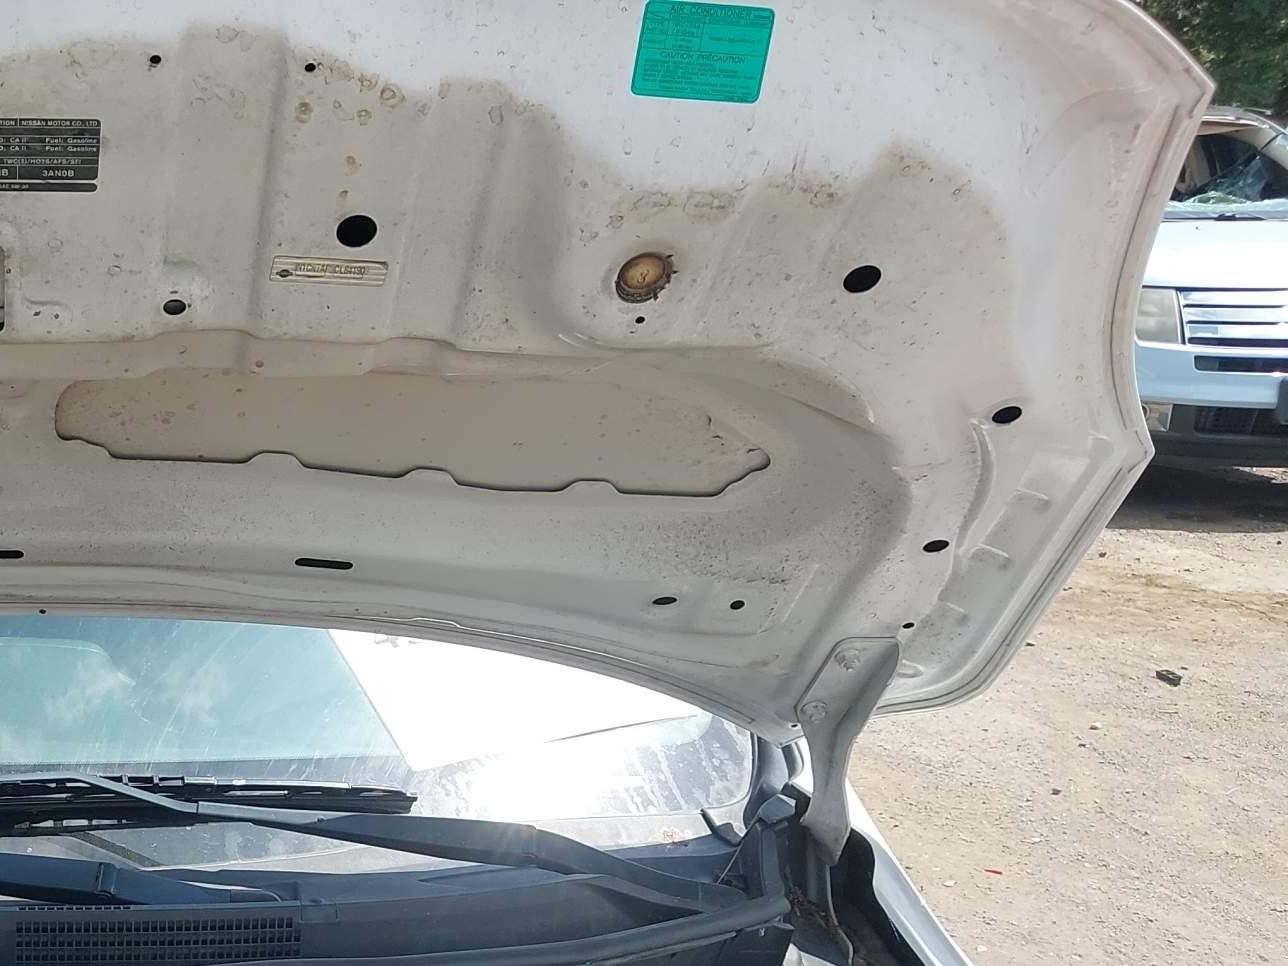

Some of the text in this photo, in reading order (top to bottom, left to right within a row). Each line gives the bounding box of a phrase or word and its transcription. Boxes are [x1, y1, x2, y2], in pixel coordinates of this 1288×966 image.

[671, 5, 685, 15] AIR
[693, 6, 752, 18] CONDITIONER
[660, 51, 693, 61] CAUTION
